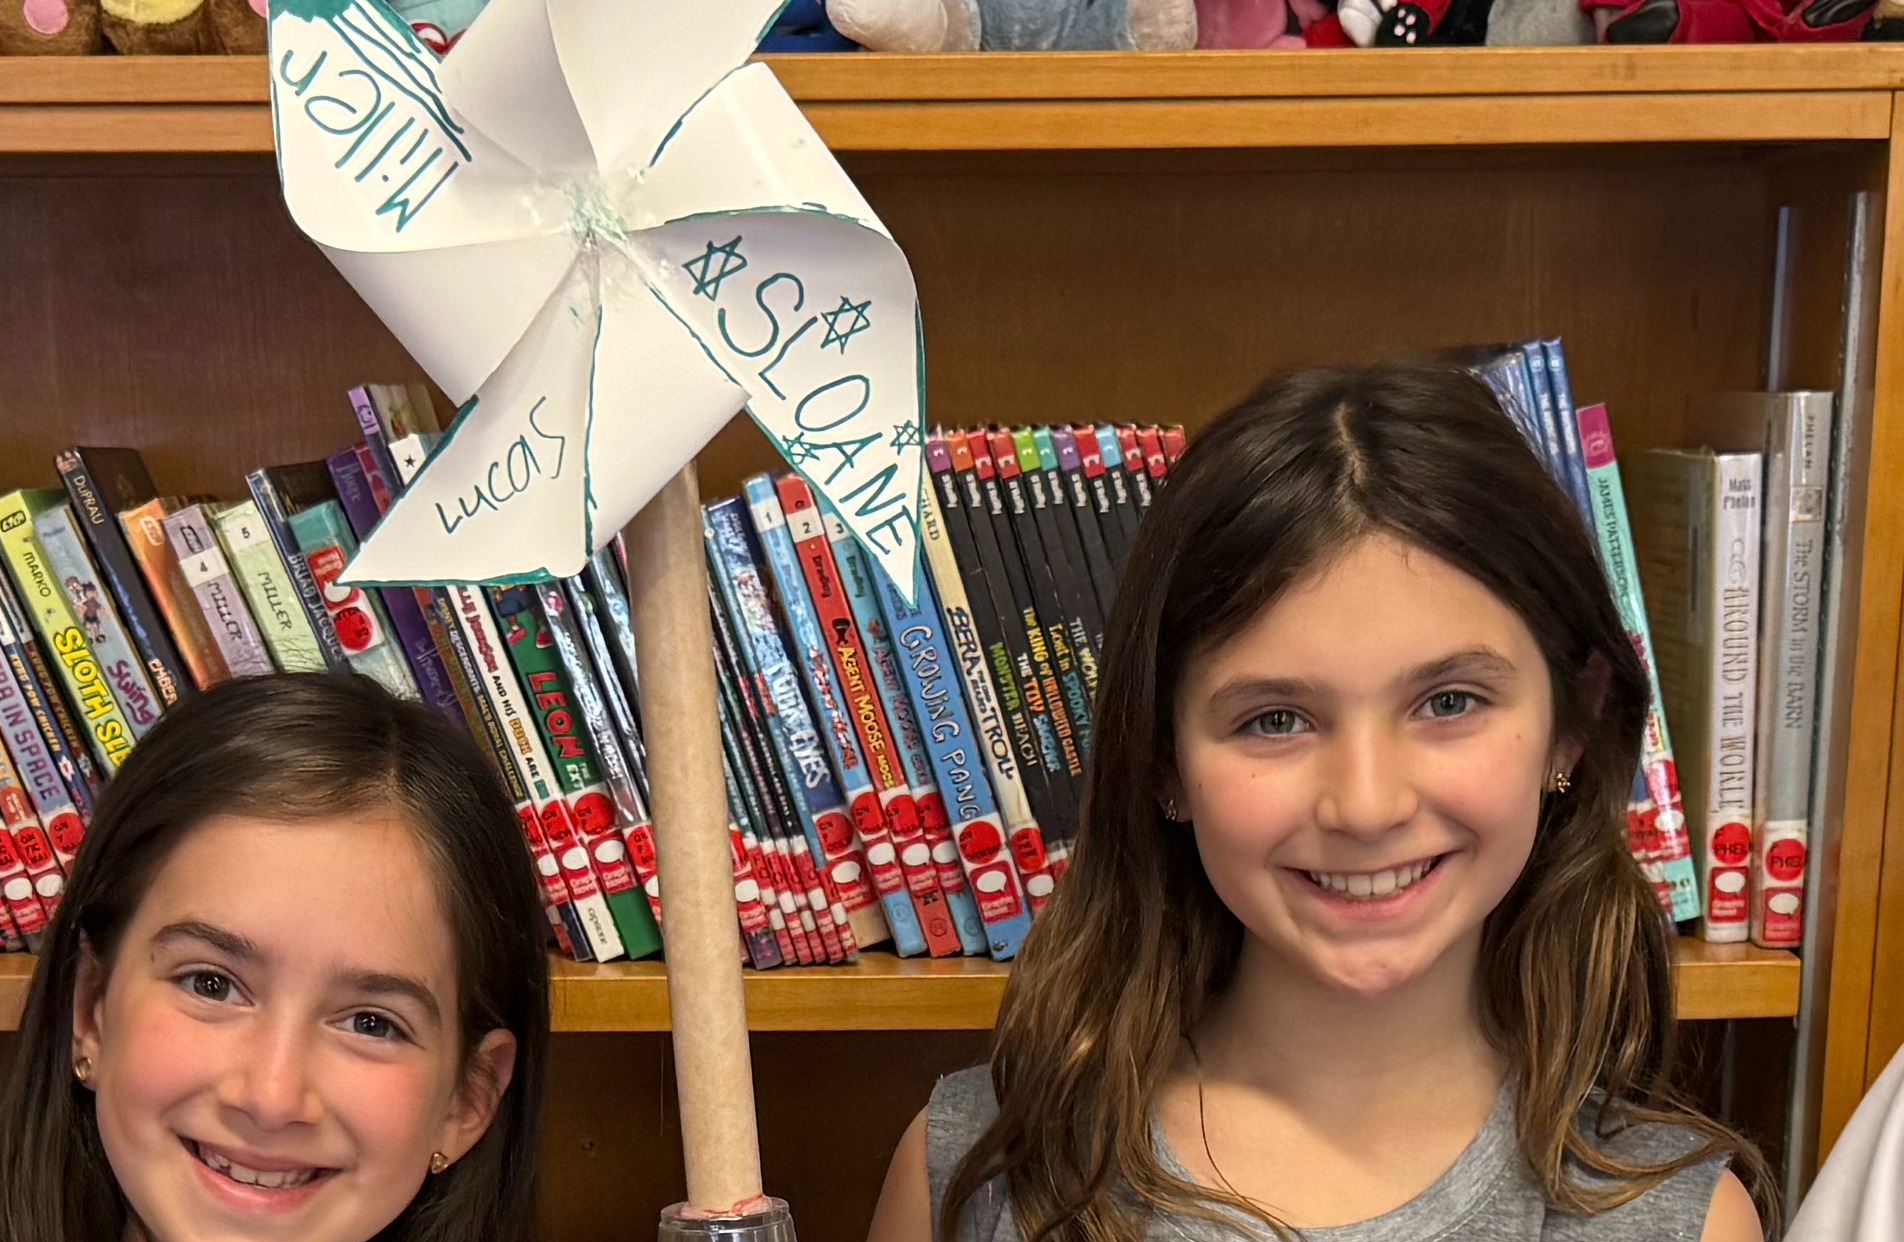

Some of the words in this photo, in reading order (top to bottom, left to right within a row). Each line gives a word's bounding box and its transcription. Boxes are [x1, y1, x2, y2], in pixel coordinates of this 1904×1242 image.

[717, 271, 917, 554] SLOANE
[21, 551, 52, 598] MARKO
[257, 571, 292, 632] MILLER
[53, 625, 114, 720] SLOTH
[946, 606, 983, 676] BERA
[1, 701, 25, 728] IN
[528, 670, 587, 760] LEON
[837, 645, 866, 695] AGENT
[854, 694, 885, 753] MOOSE
[900, 625, 961, 743] GROWING
[942, 748, 982, 822] PANG
[12, 725, 57, 800] SPACE
